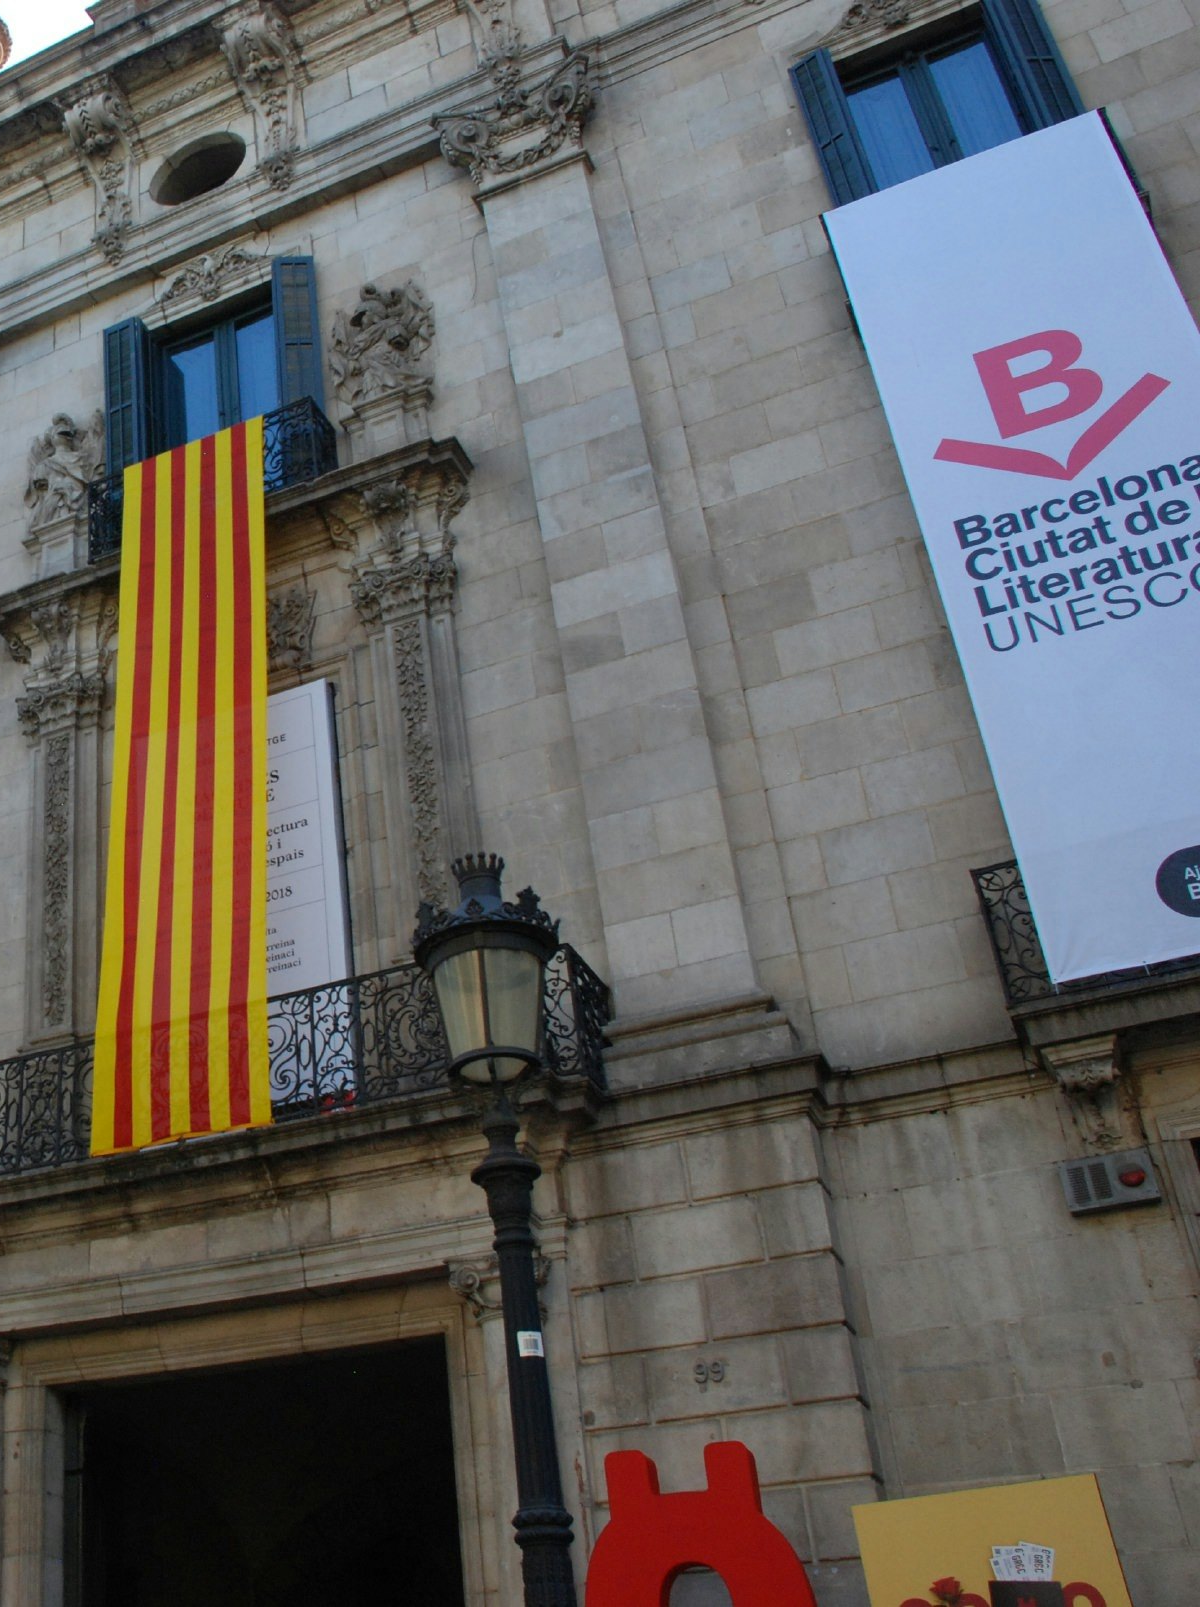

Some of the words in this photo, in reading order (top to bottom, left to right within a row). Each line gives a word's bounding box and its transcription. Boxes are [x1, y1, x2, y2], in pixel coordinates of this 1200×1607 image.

[973, 329, 1103, 439] B
[953, 454, 1200, 550] Barcelona
[965, 516, 1117, 581] Ciutat
[1125, 499, 1191, 535] de
[974, 530, 1200, 617] Literatur
[266, 733, 287, 746] TGE
[266, 818, 308, 837] ectura
[266, 938, 295, 951] rreina
[266, 947, 295, 962] einaci
[266, 957, 301, 973] reinaci
